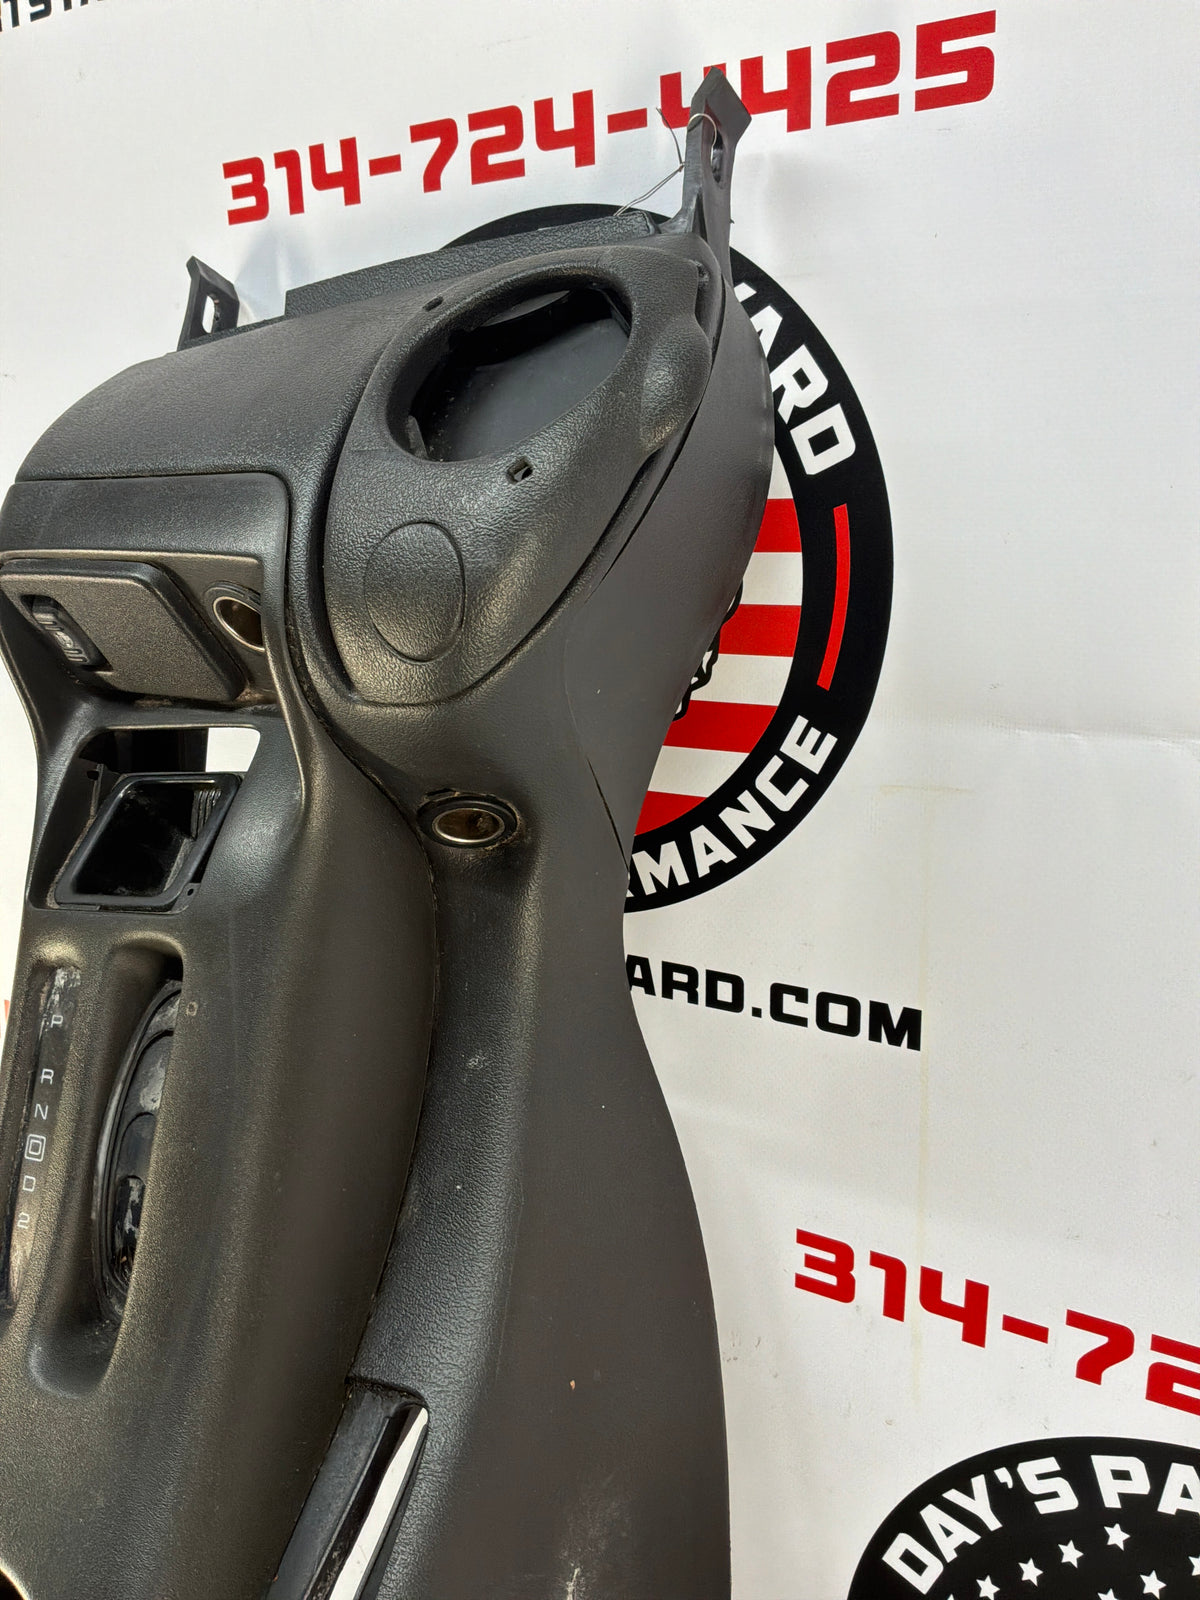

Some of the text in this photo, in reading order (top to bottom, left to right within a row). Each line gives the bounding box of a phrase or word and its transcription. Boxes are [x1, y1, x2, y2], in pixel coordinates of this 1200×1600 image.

[626, 715, 838, 897] MANCE
[50, 1014, 64, 1029] P
[40, 1068, 55, 1085] R
[34, 1103, 49, 1121] N
[17, 1212, 30, 1229] 2
[794, 1228, 1200, 1416] 314-72
[881, 1454, 1200, 1595] DAY'S PA
